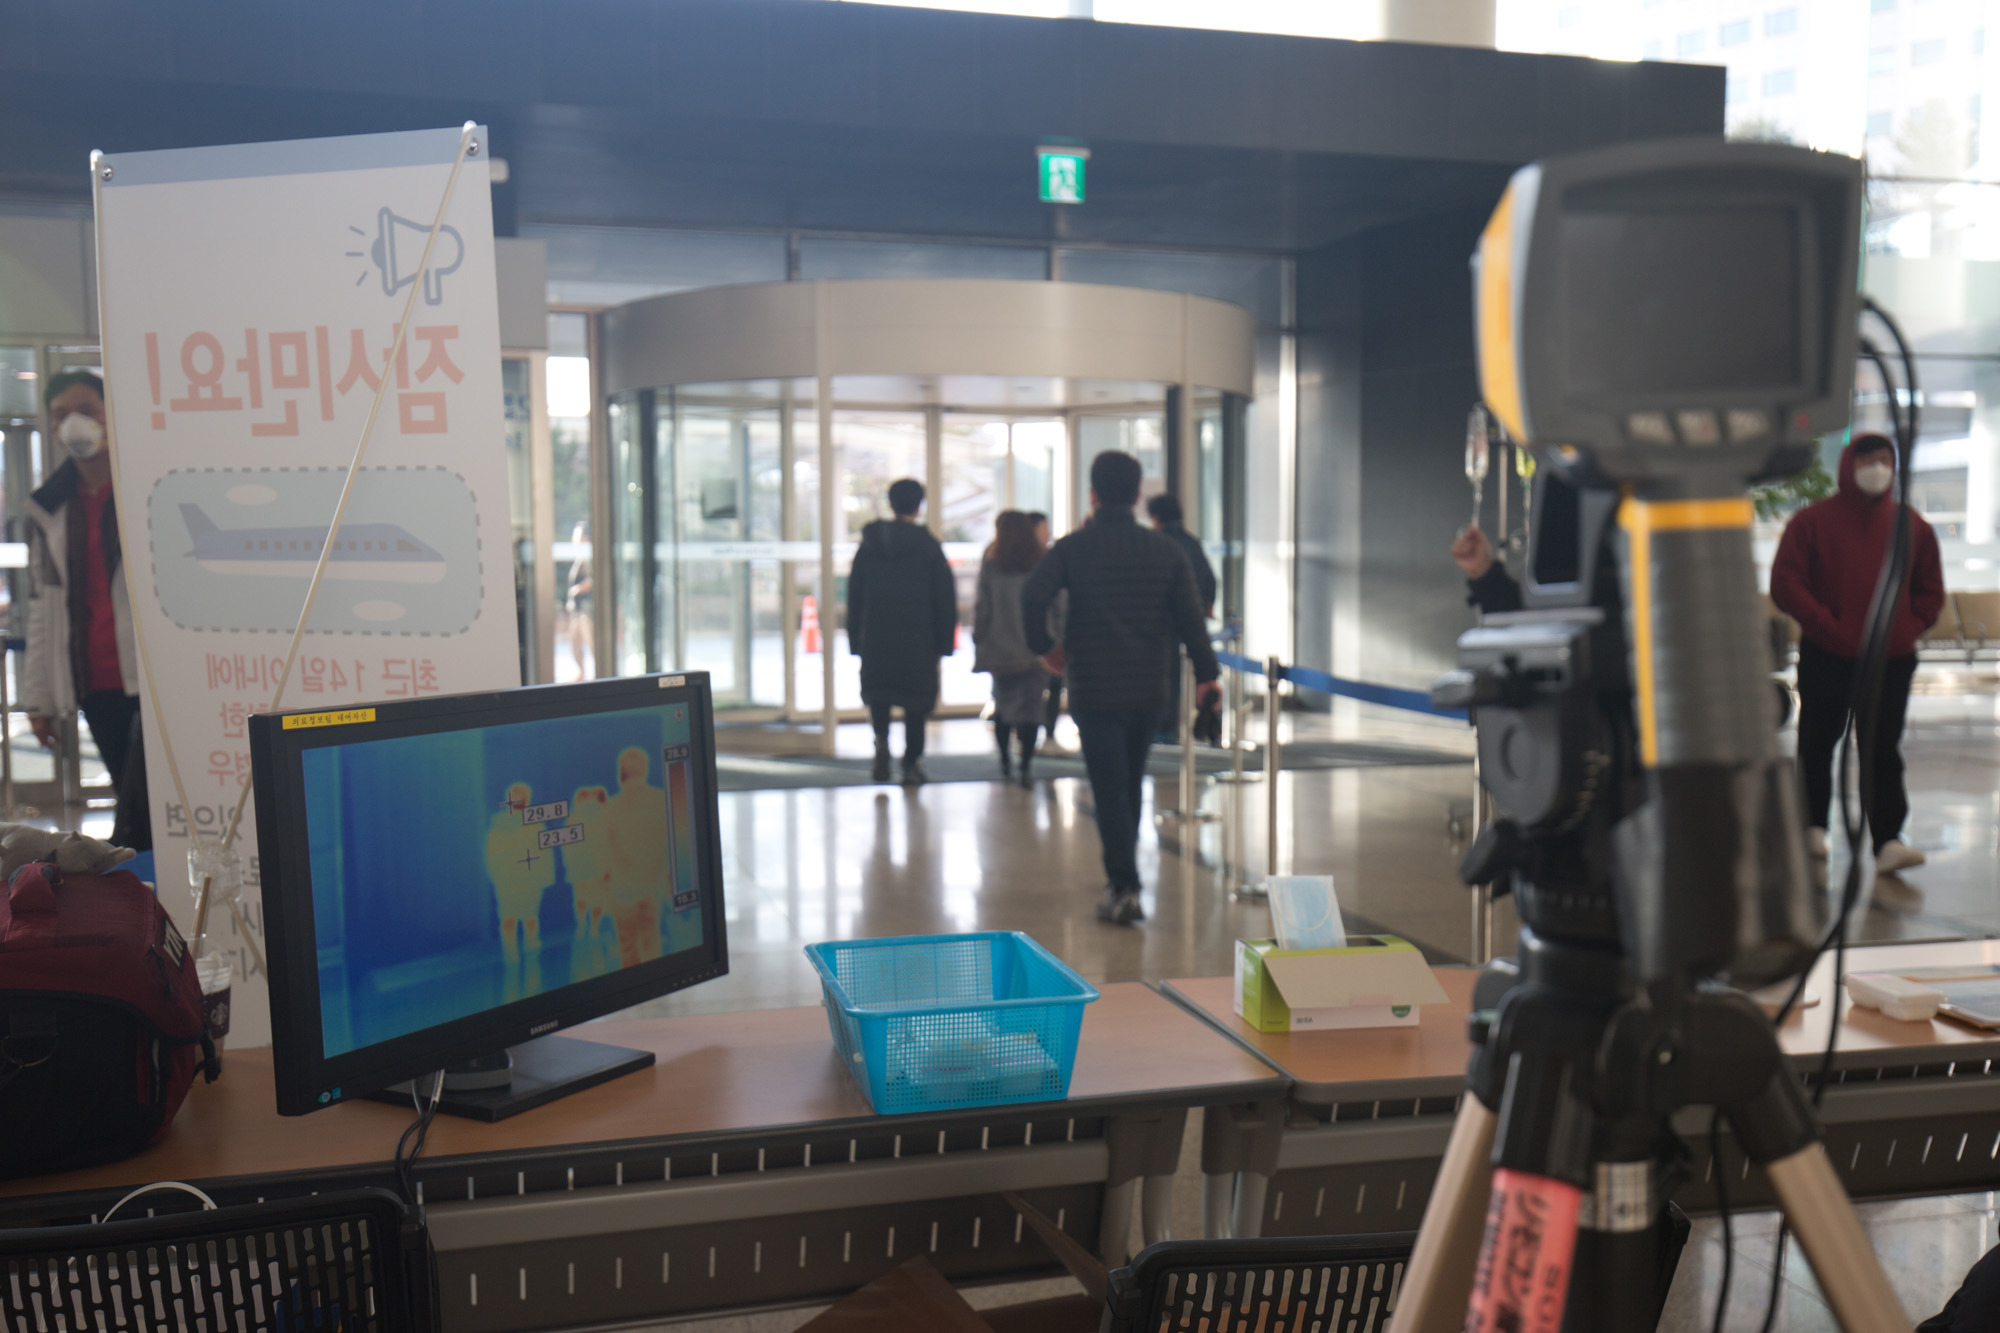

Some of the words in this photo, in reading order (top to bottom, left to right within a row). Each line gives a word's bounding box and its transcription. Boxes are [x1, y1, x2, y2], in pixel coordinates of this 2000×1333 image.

[666, 746, 689, 760] 28.9
[527, 804, 563, 822] 29.8
[542, 828, 579, 847] 23.5
